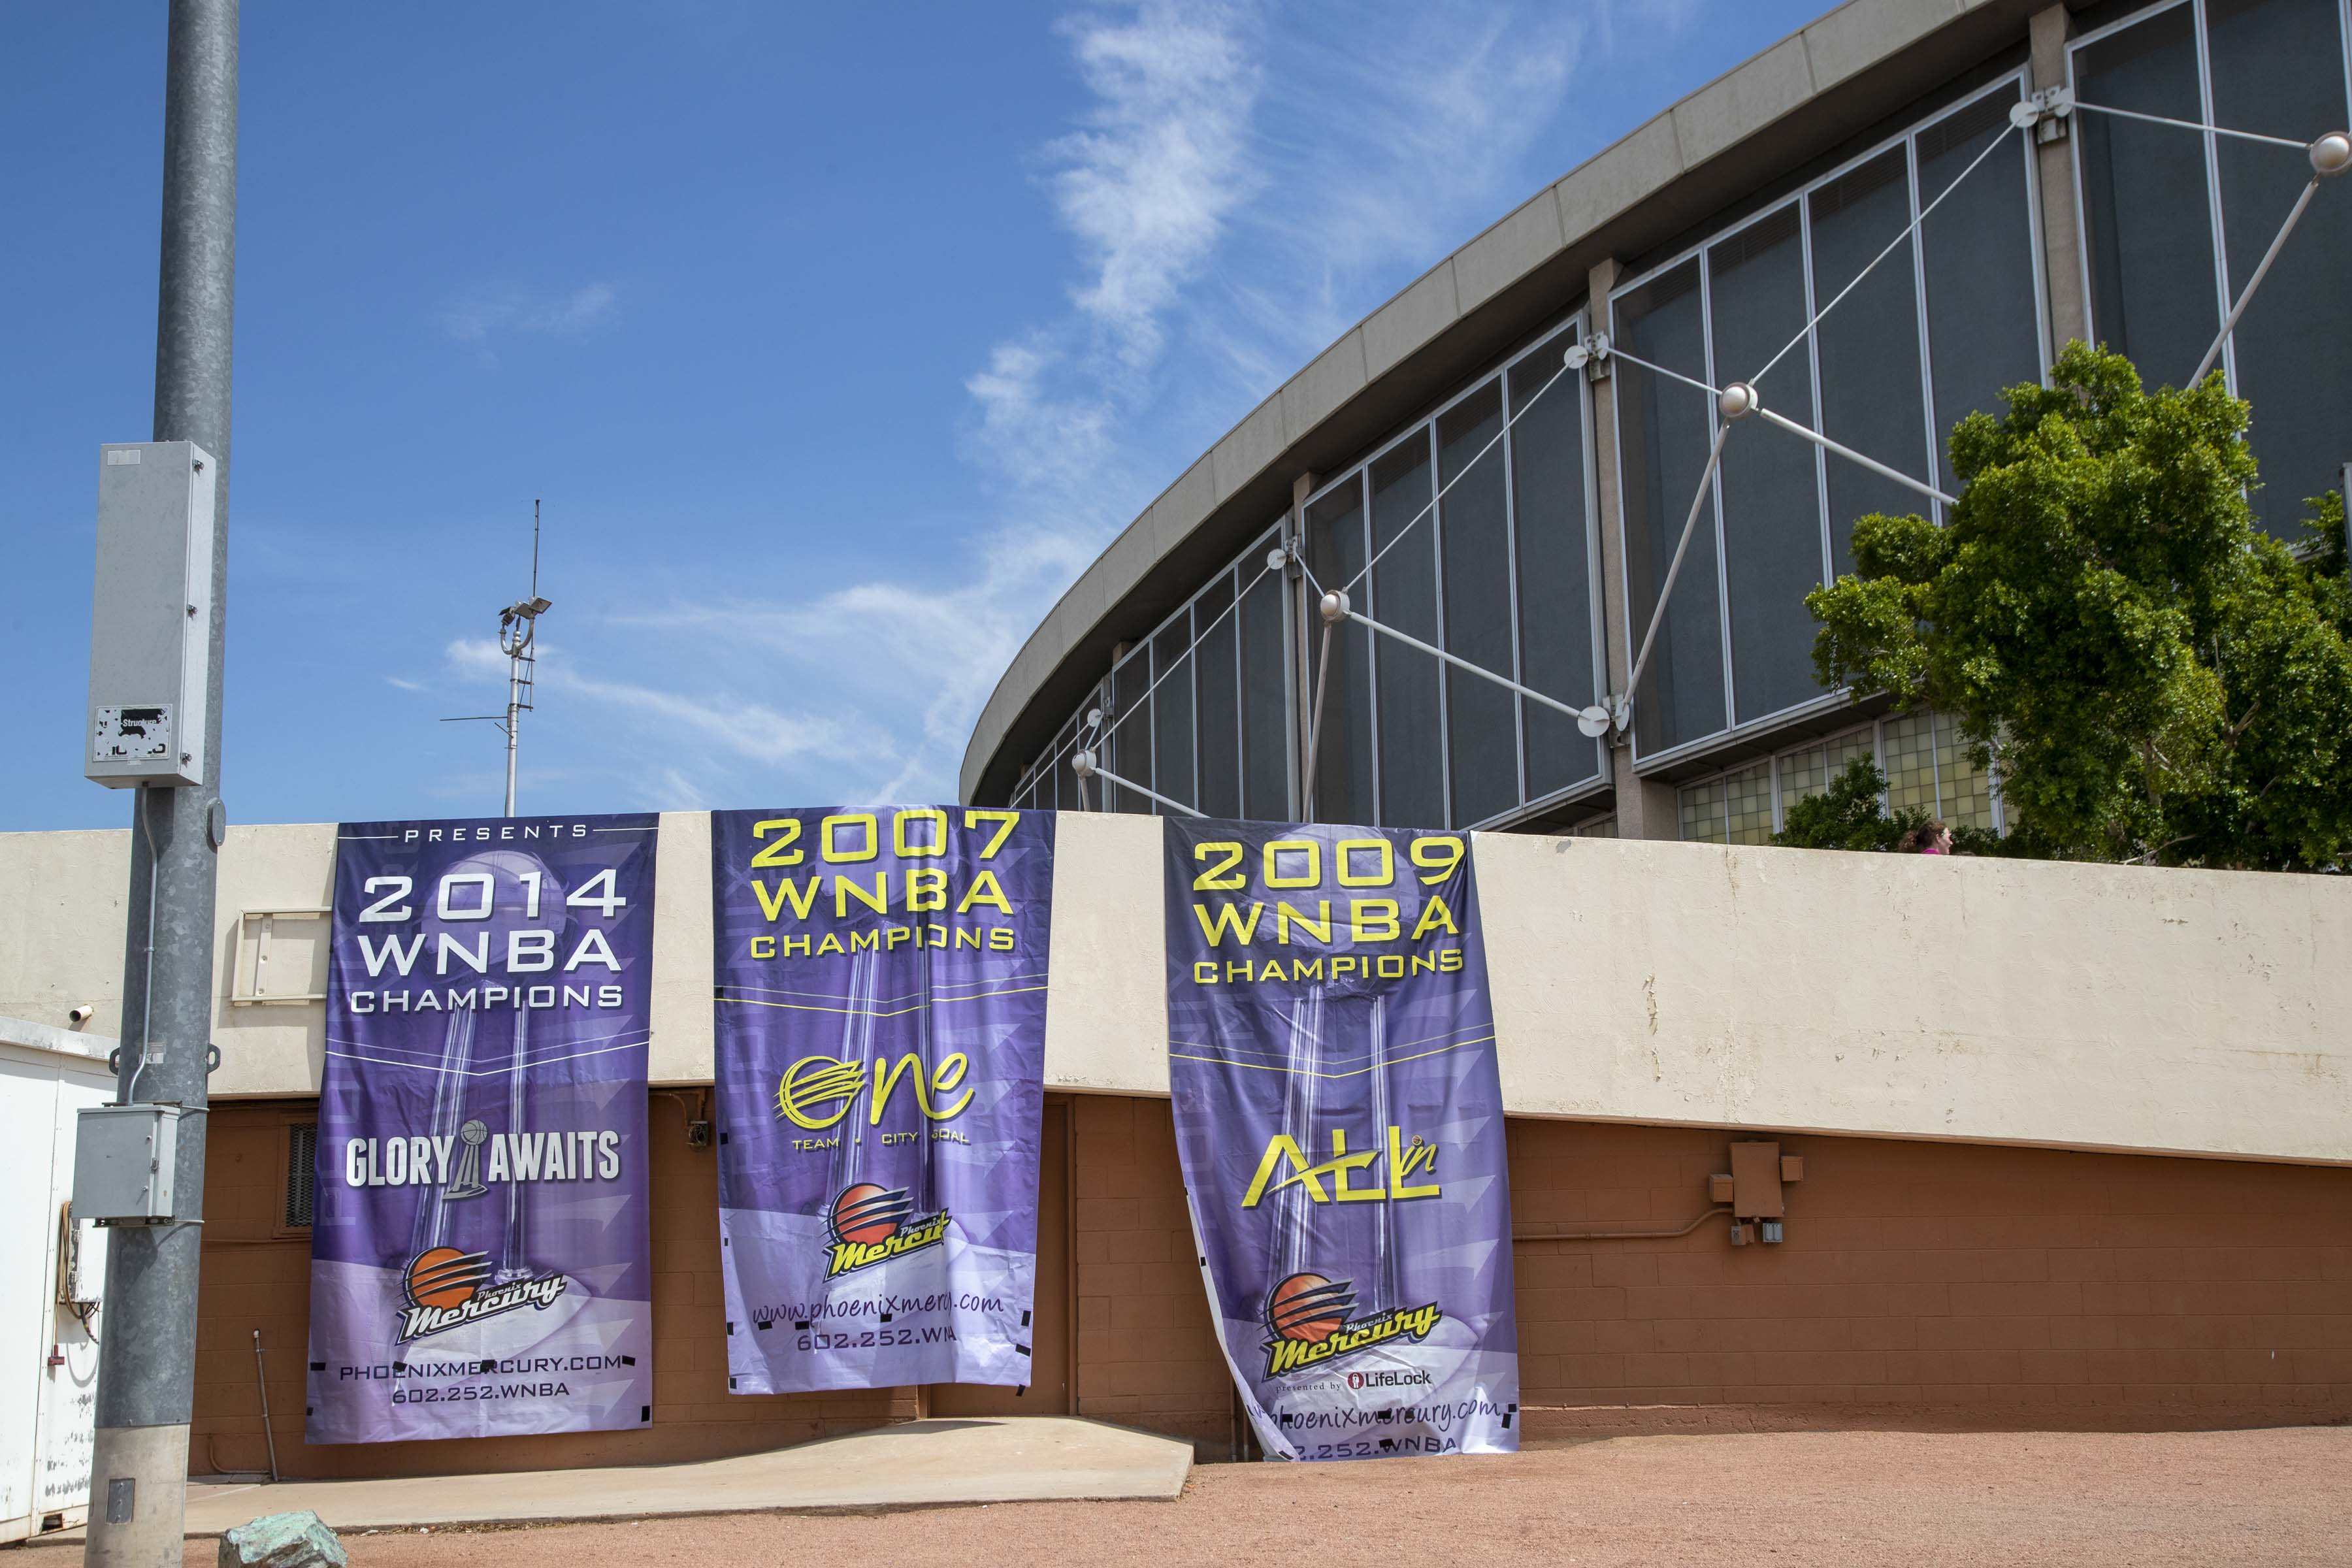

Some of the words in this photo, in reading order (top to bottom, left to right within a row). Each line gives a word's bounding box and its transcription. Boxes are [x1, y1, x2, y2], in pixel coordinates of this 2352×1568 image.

[404, 825, 586, 843] PRESENTS
[751, 809, 1019, 868] 2007
[1194, 836, 1464, 890] 2009
[359, 869, 627, 923] 2014
[751, 868, 1013, 921] WNBA
[751, 924, 1013, 958] CHAMPIONS
[1194, 895, 1459, 947] WNBA
[357, 929, 621, 976] WNBA
[1194, 949, 1463, 984] CHAMPIONS
[350, 985, 622, 1013] CHAMPIONS
[346, 1134, 454, 1187] GLORY
[487, 1130, 619, 1183] AWAITS
[792, 1137, 838, 1150] TEAM
[882, 1132, 918, 1143] CITY
[405, 1276, 566, 1339] Mercury
[477, 1282, 521, 1301] Phoenix
[1270, 1305, 1440, 1373] Mercury
[1345, 1312, 1392, 1333] Phoenix
[393, 1382, 570, 1403] 602.252.WNBA
[1276, 1382, 1325, 1393] presented
[1330, 1381, 1341, 1391] by
[1365, 1371, 1431, 1387] LifeLock
